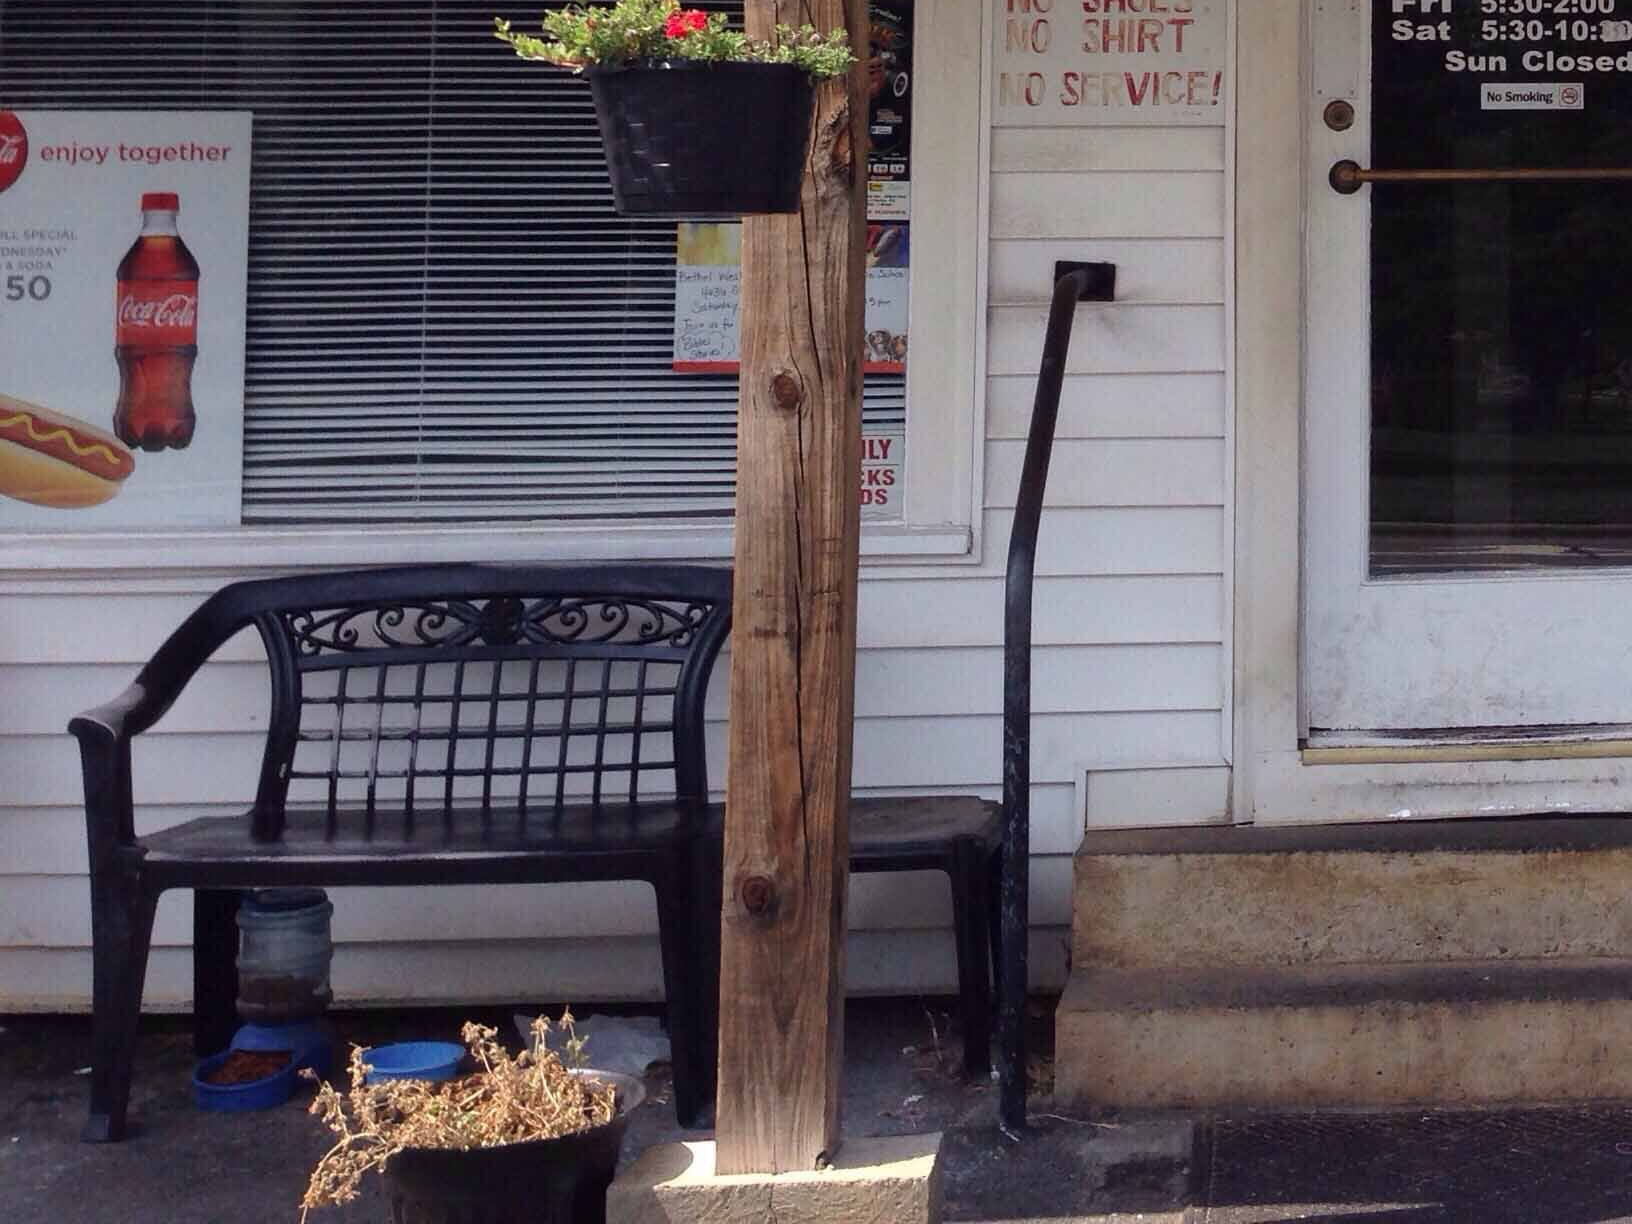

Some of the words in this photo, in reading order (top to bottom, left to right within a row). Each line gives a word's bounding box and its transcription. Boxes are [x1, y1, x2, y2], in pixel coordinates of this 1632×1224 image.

[1005, 18, 1051, 53] NO
[1082, 18, 1194, 53] SHIRT
[1391, 19, 1451, 42] Sat
[1481, 20, 1632, 42] 5:30-10:
[1445, 50, 1506, 72] Sun
[1000, 72, 1046, 106] NO
[1059, 71, 1222, 106] SERVICE!
[1487, 91, 1502, 103] No
[1505, 91, 1553, 105] Smoking
[40, 143, 109, 165] enjoy
[118, 143, 232, 165] together
